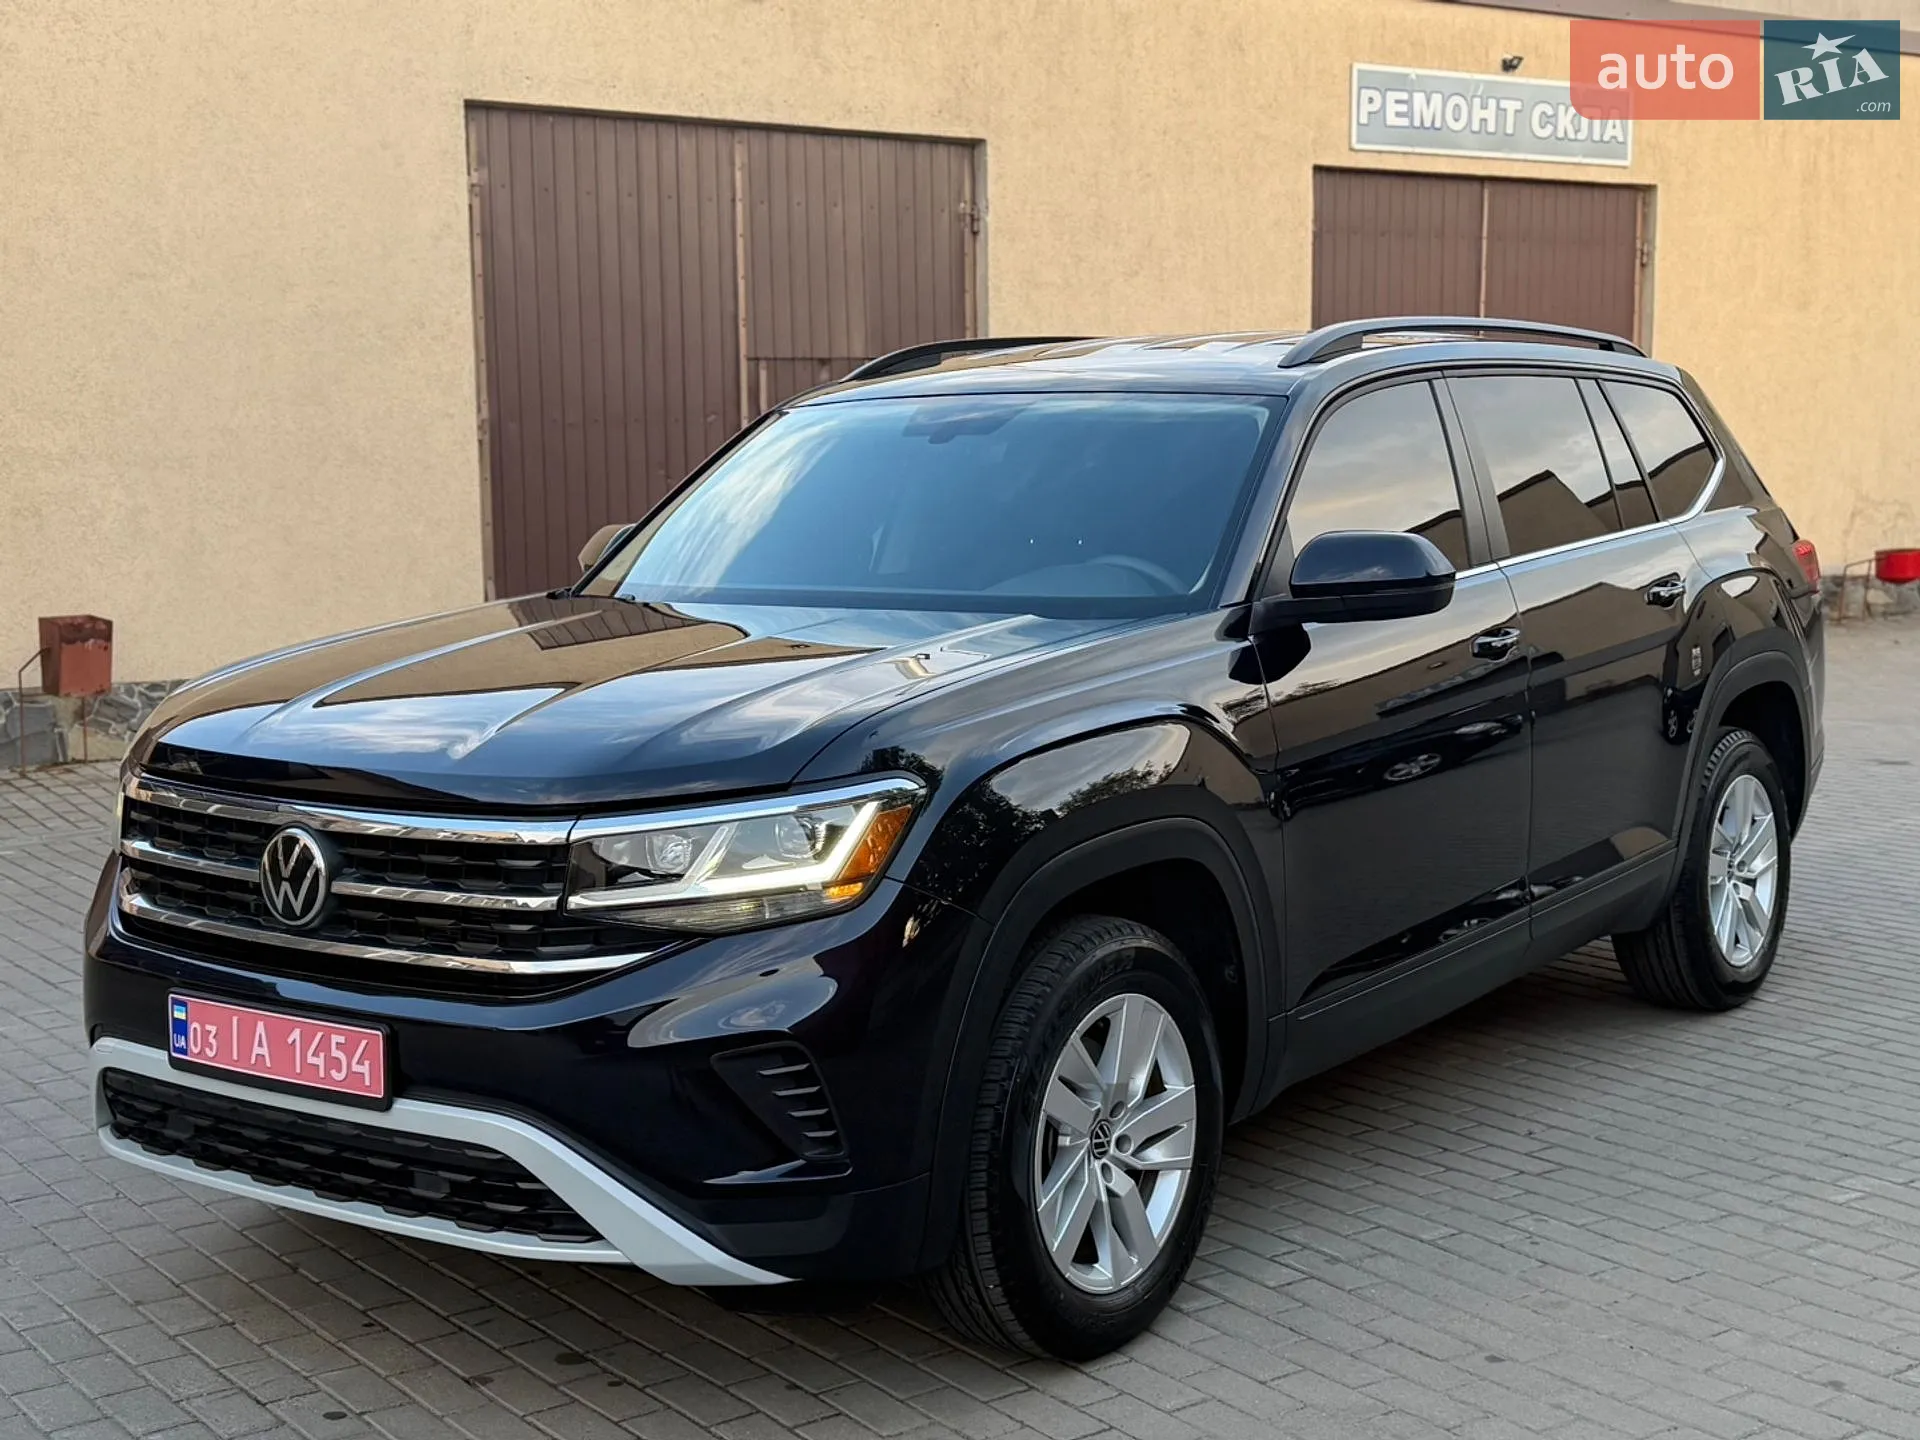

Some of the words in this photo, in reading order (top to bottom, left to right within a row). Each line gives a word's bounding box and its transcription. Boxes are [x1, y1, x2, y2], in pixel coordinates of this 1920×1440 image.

[1358, 87, 1523, 135] РЕМОНТ
[1530, 101, 1626, 144] СКЛА
[173, 1034, 187, 1049] UA
[190, 1023, 217, 1058] 03
[287, 1028, 371, 1087] 1454
